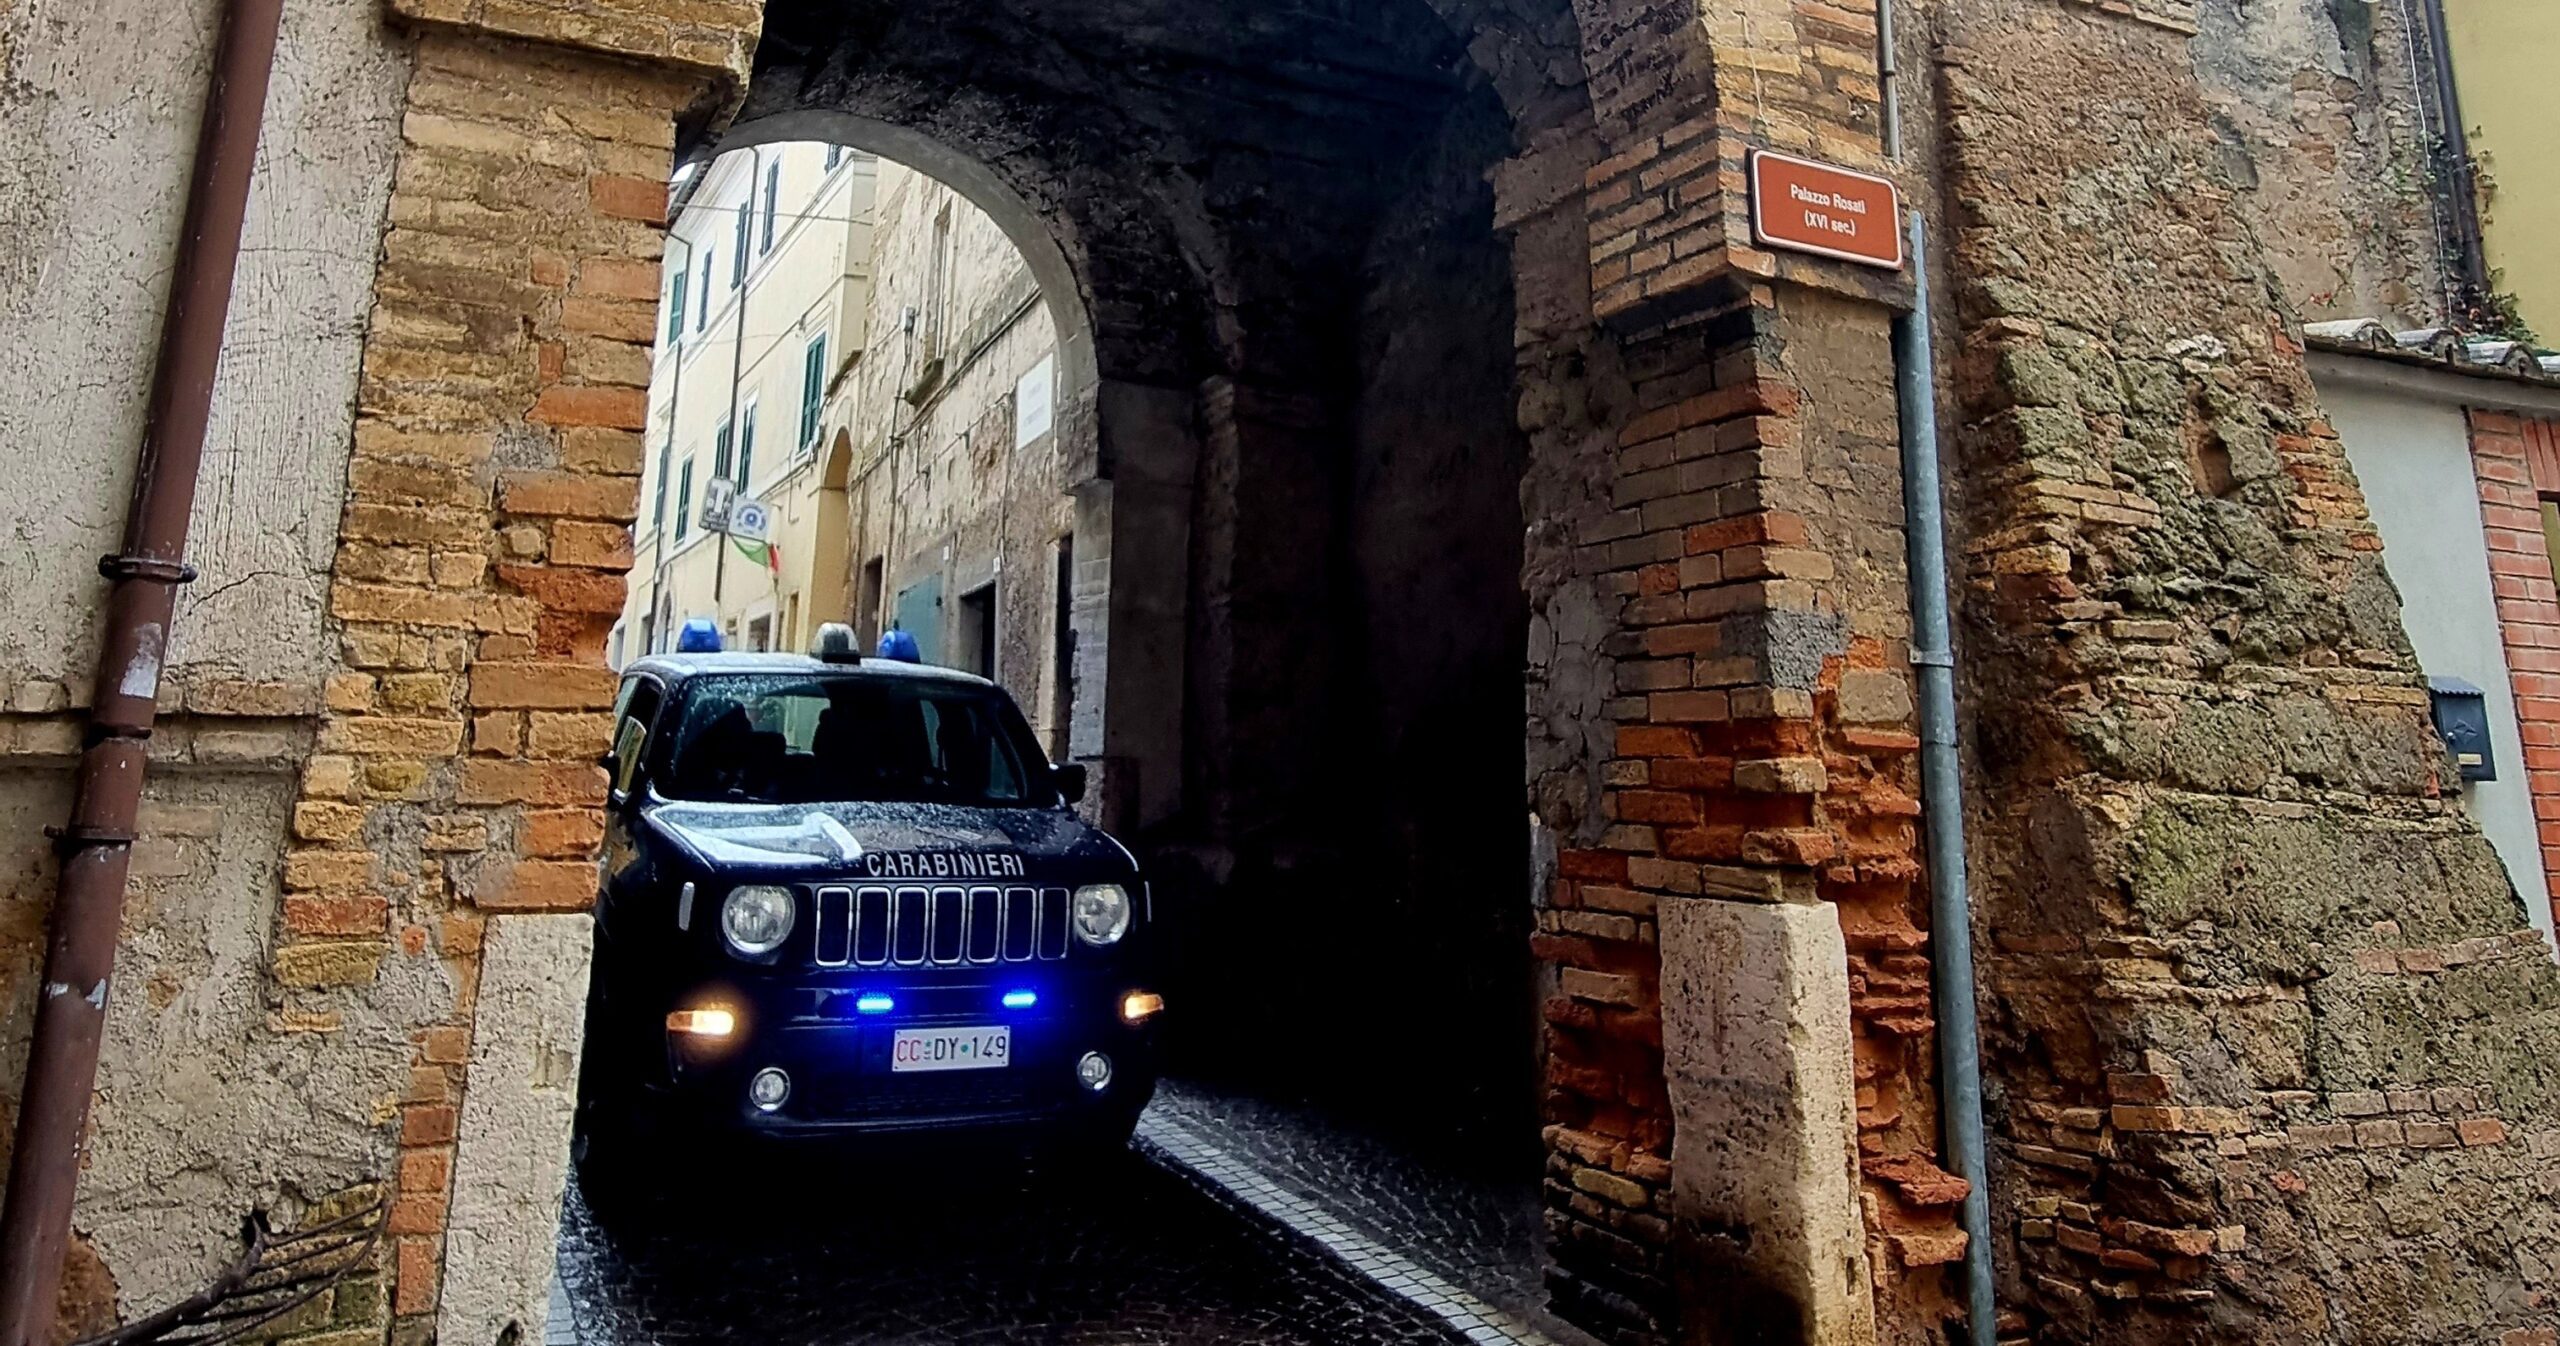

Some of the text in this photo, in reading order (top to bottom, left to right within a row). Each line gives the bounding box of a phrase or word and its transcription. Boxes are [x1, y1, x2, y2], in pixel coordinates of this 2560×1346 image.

[1790, 183, 1866, 215] Palazzo Rosati
[1804, 209, 1856, 238] (XVI sec.)
[866, 853, 1025, 877] CARABINIERI
[972, 1035, 1006, 1059] 149
